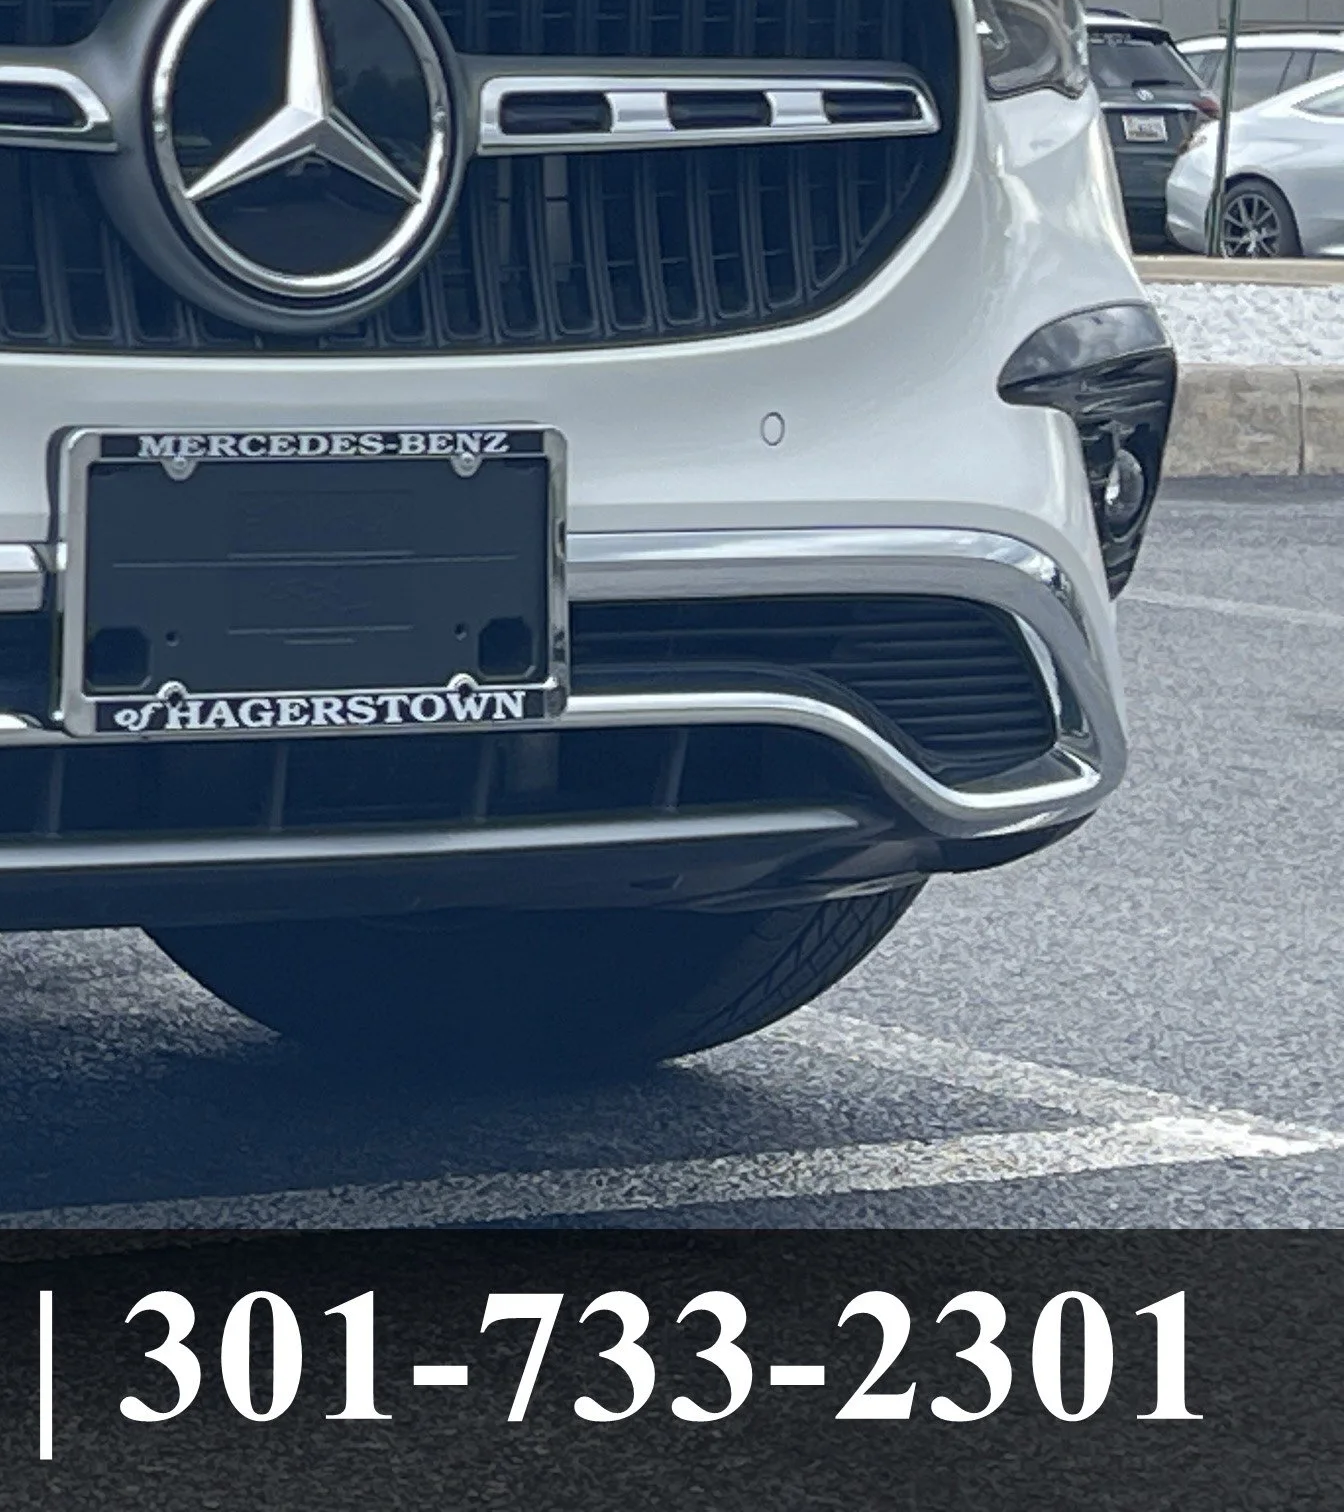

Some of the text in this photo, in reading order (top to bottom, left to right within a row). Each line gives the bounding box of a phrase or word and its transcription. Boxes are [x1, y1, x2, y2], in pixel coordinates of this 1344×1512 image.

[137, 431, 510, 459] MERCEDES-BENZ
[114, 690, 527, 731] of HAGERSTOWN
